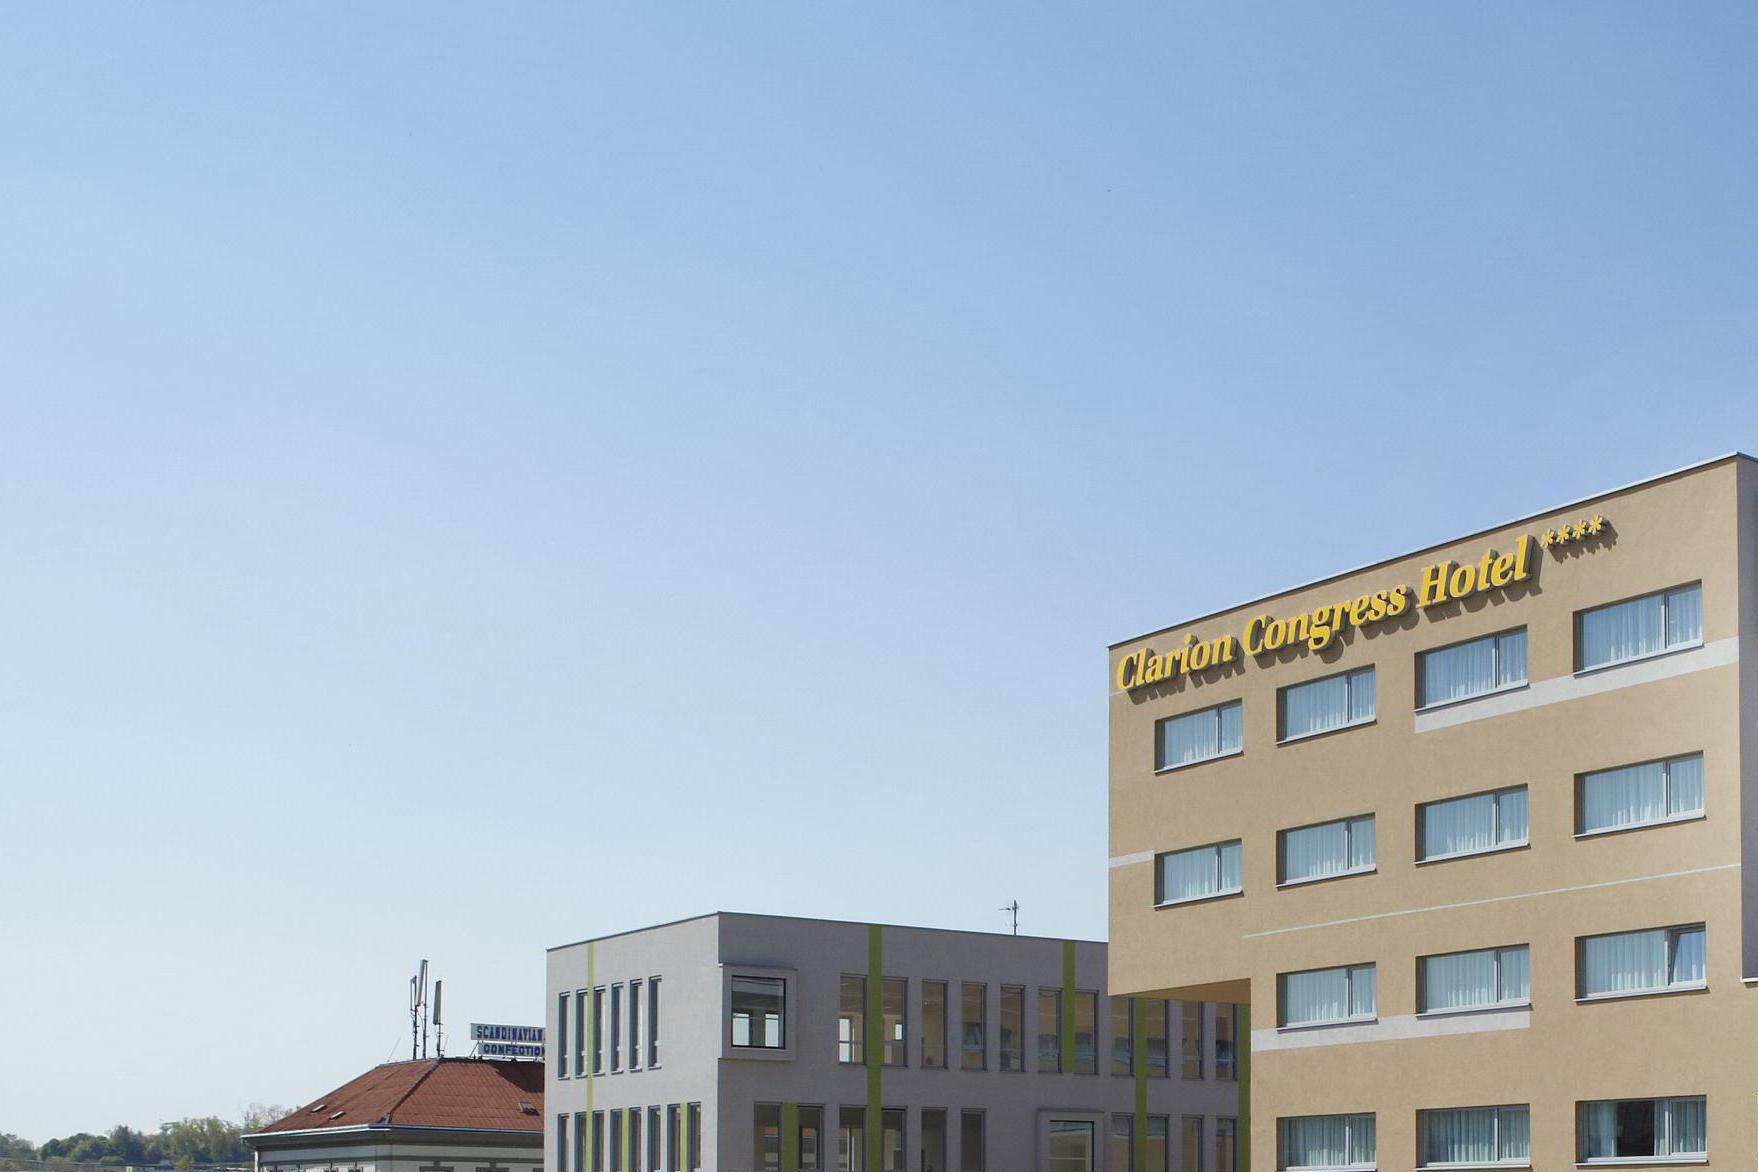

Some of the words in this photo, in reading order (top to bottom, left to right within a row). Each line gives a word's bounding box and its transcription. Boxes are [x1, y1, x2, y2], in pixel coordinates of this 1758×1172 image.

[1116, 633, 1235, 690] Clarion
[1242, 583, 1408, 656] Congress
[1415, 534, 1531, 609] Hotel
[476, 1025, 543, 1041] SCANDINAVIAN
